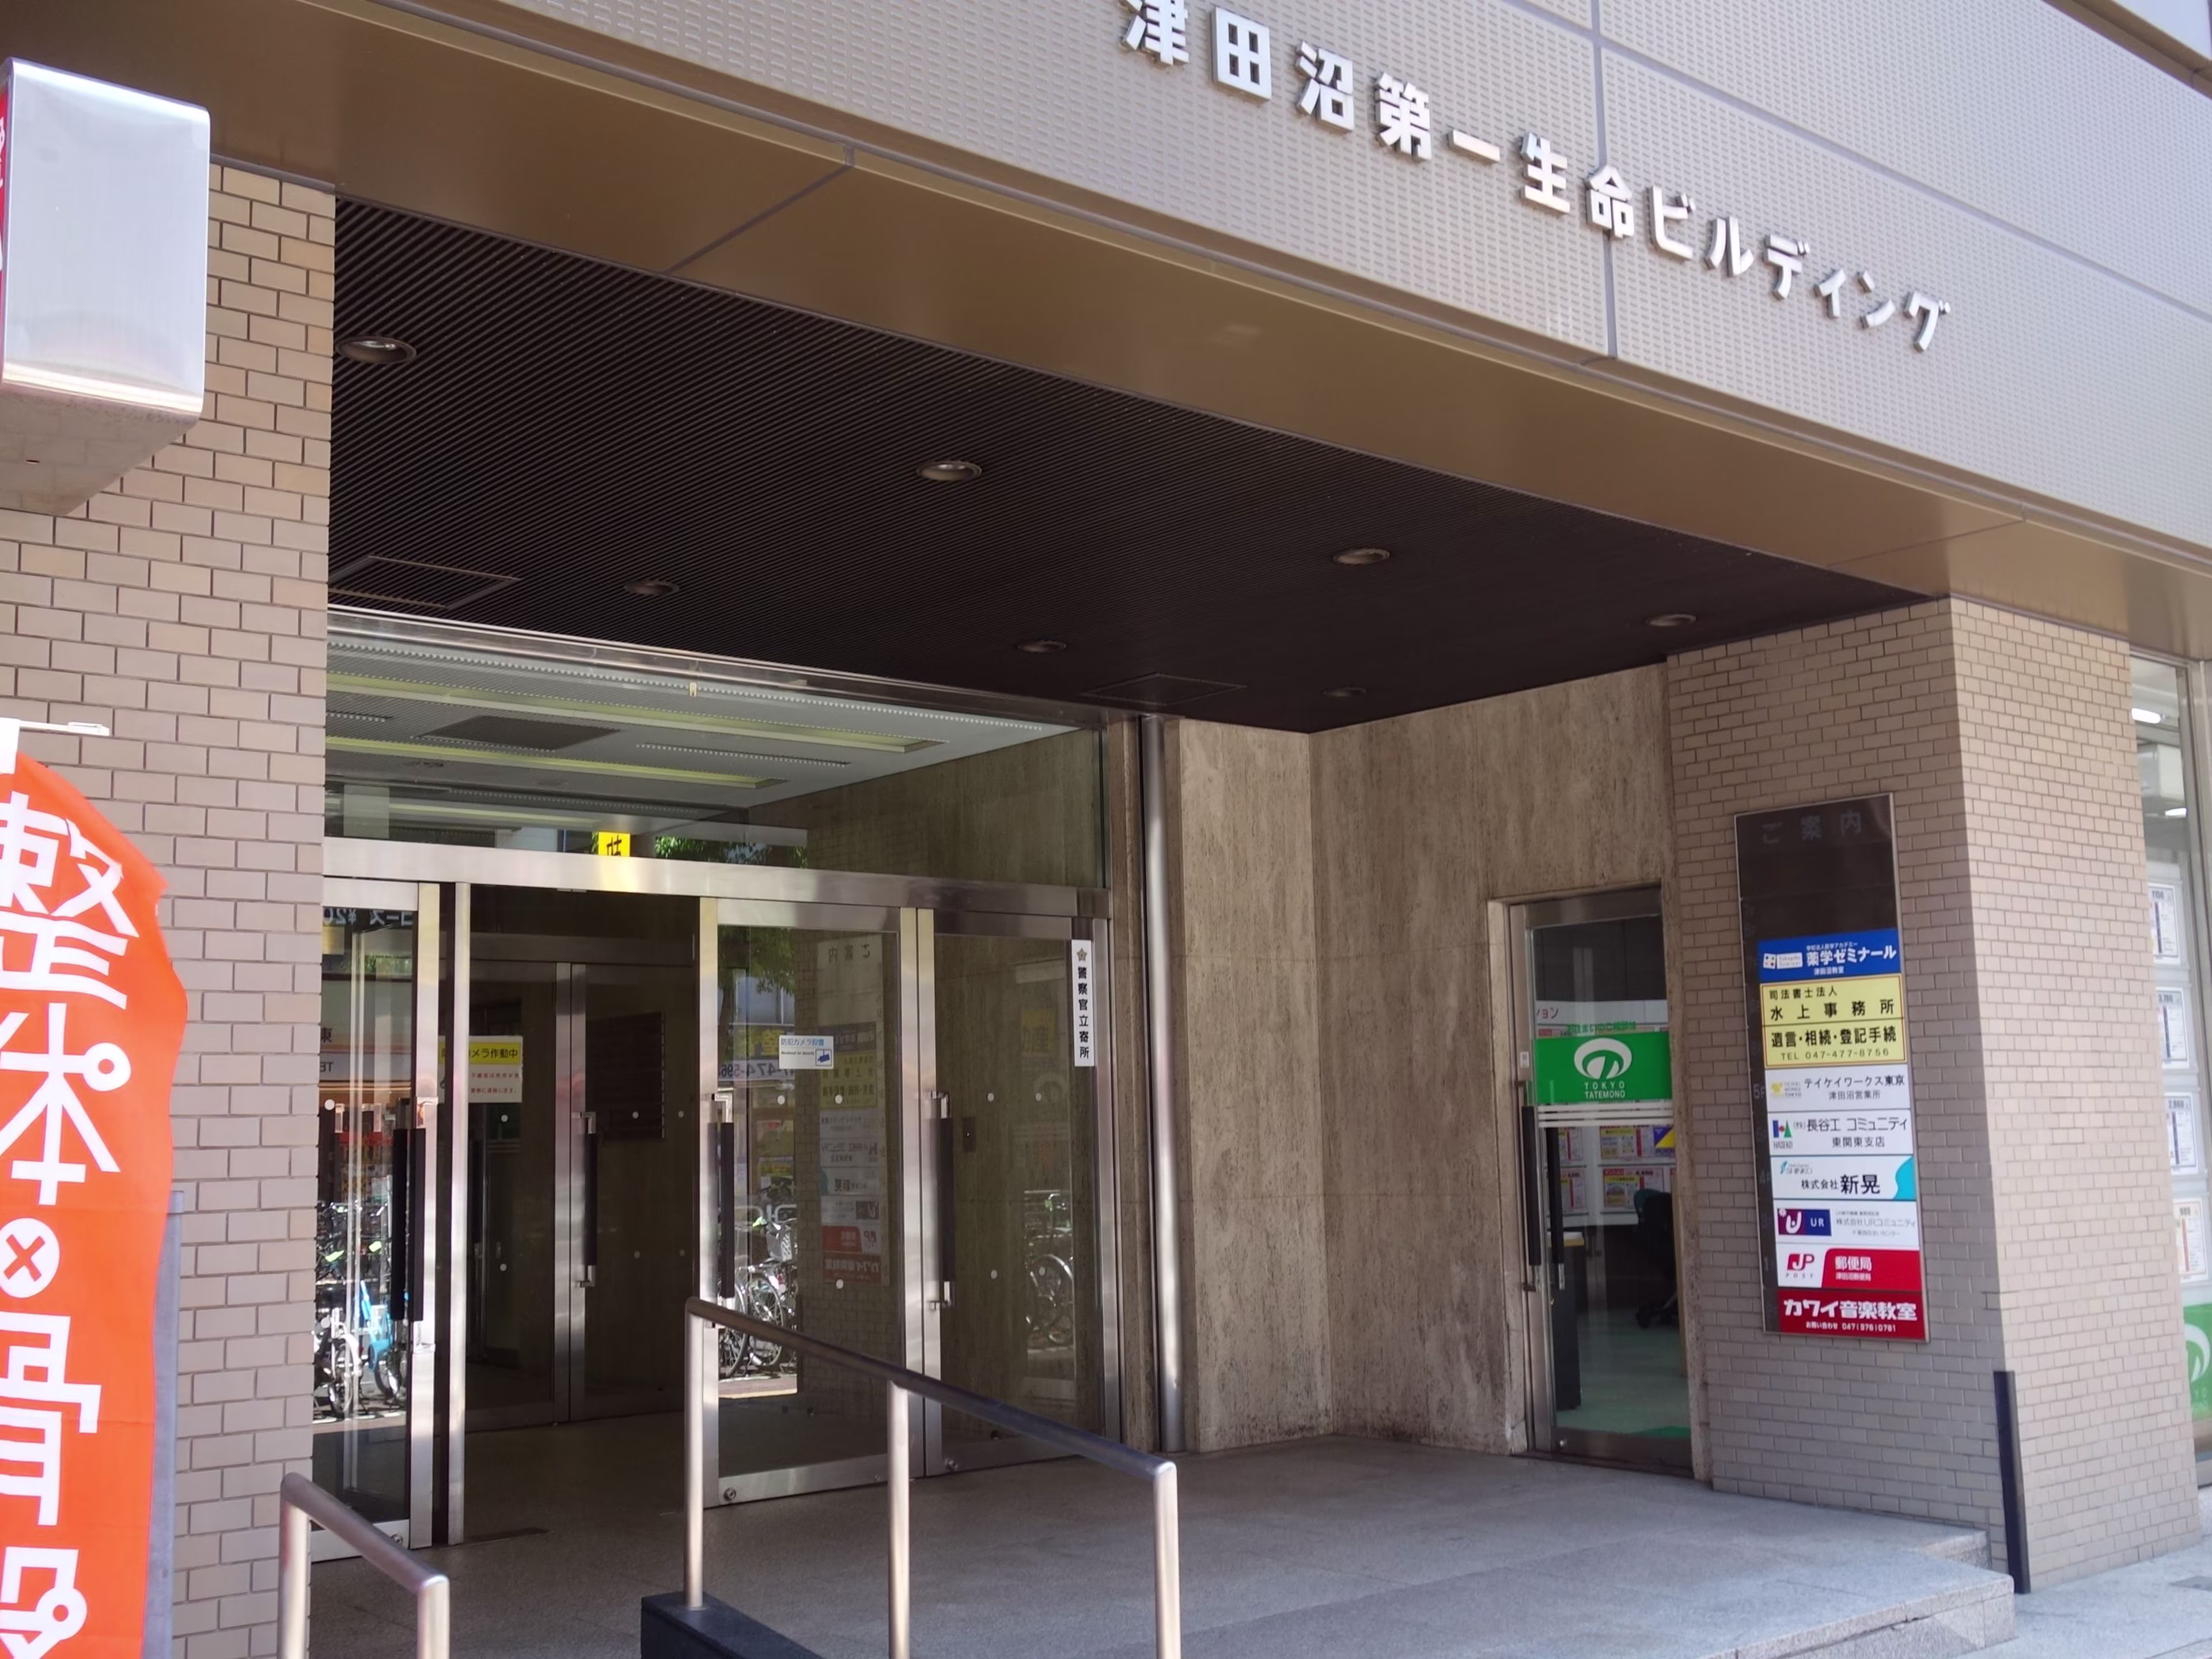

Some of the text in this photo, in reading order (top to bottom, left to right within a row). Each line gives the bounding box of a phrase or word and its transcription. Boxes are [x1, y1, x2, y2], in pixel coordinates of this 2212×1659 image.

[1121, 0, 1950, 351] 津田沼第一生命ビルディング
[1762, 810, 1862, 844] ご案内
[1806, 945, 1897, 967] 薬学ゼミナール
[1770, 986, 1838, 1001] 司法書士法人
[1077, 967, 1089, 1059] 警察官立寄所
[1771, 999, 1894, 1021] 水上事務所
[1771, 1025, 1896, 1048] 遺言・相続・登記手続
[1781, 1052, 1799, 1060] TEL
[1585, 1081, 1624, 1090] TOKYO
[1804, 1075, 1905, 1089] テイケイワークス東京
[1585, 1090, 1626, 1099] TATEMONO
[1829, 1089, 1881, 1100] 津田沼営業所
[1832, 1136, 1885, 1148] 東関東支店
[1810, 1217, 1825, 1228] UR
[1835, 1256, 1872, 1272] 郵便局
[1783, 1298, 1918, 1321] カワイ音楽教室
